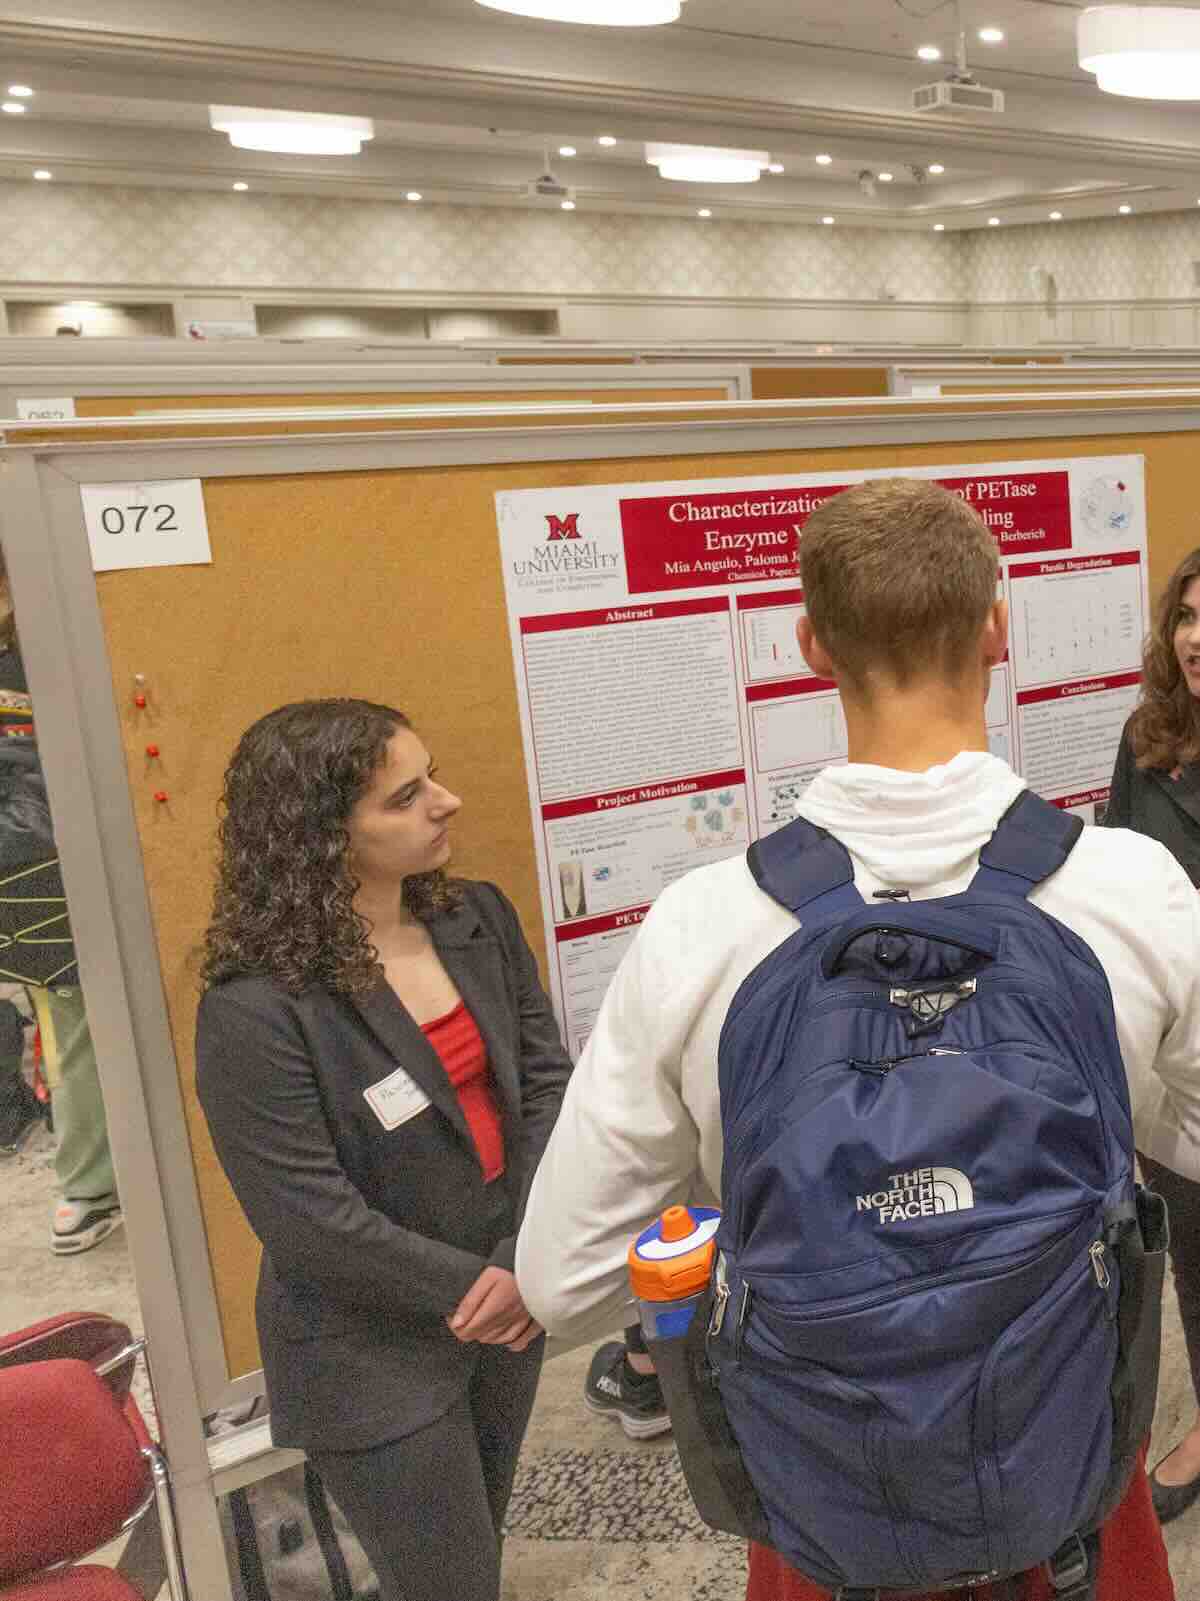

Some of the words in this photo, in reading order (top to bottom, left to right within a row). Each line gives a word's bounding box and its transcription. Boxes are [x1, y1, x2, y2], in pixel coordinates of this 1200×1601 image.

[668, 493, 826, 522] Characterizatio
[976, 481, 1037, 500] PETase
[102, 504, 178, 534] 072
[544, 513, 582, 541] M
[704, 530, 788, 551] Enzyme
[981, 508, 1014, 528] ling
[513, 553, 619, 575] UNIVERSITY
[534, 542, 598, 560] MIAMI
[664, 560, 690, 575] Mia
[691, 556, 742, 573] Angulo,
[744, 553, 789, 567] Paloma
[606, 608, 654, 621] Abstract
[597, 792, 636, 809] Project
[639, 782, 698, 799] Motivation
[888, 1167, 932, 1189] THE
[856, 1182, 934, 1211] NORTH
[879, 1199, 935, 1225] FACE
